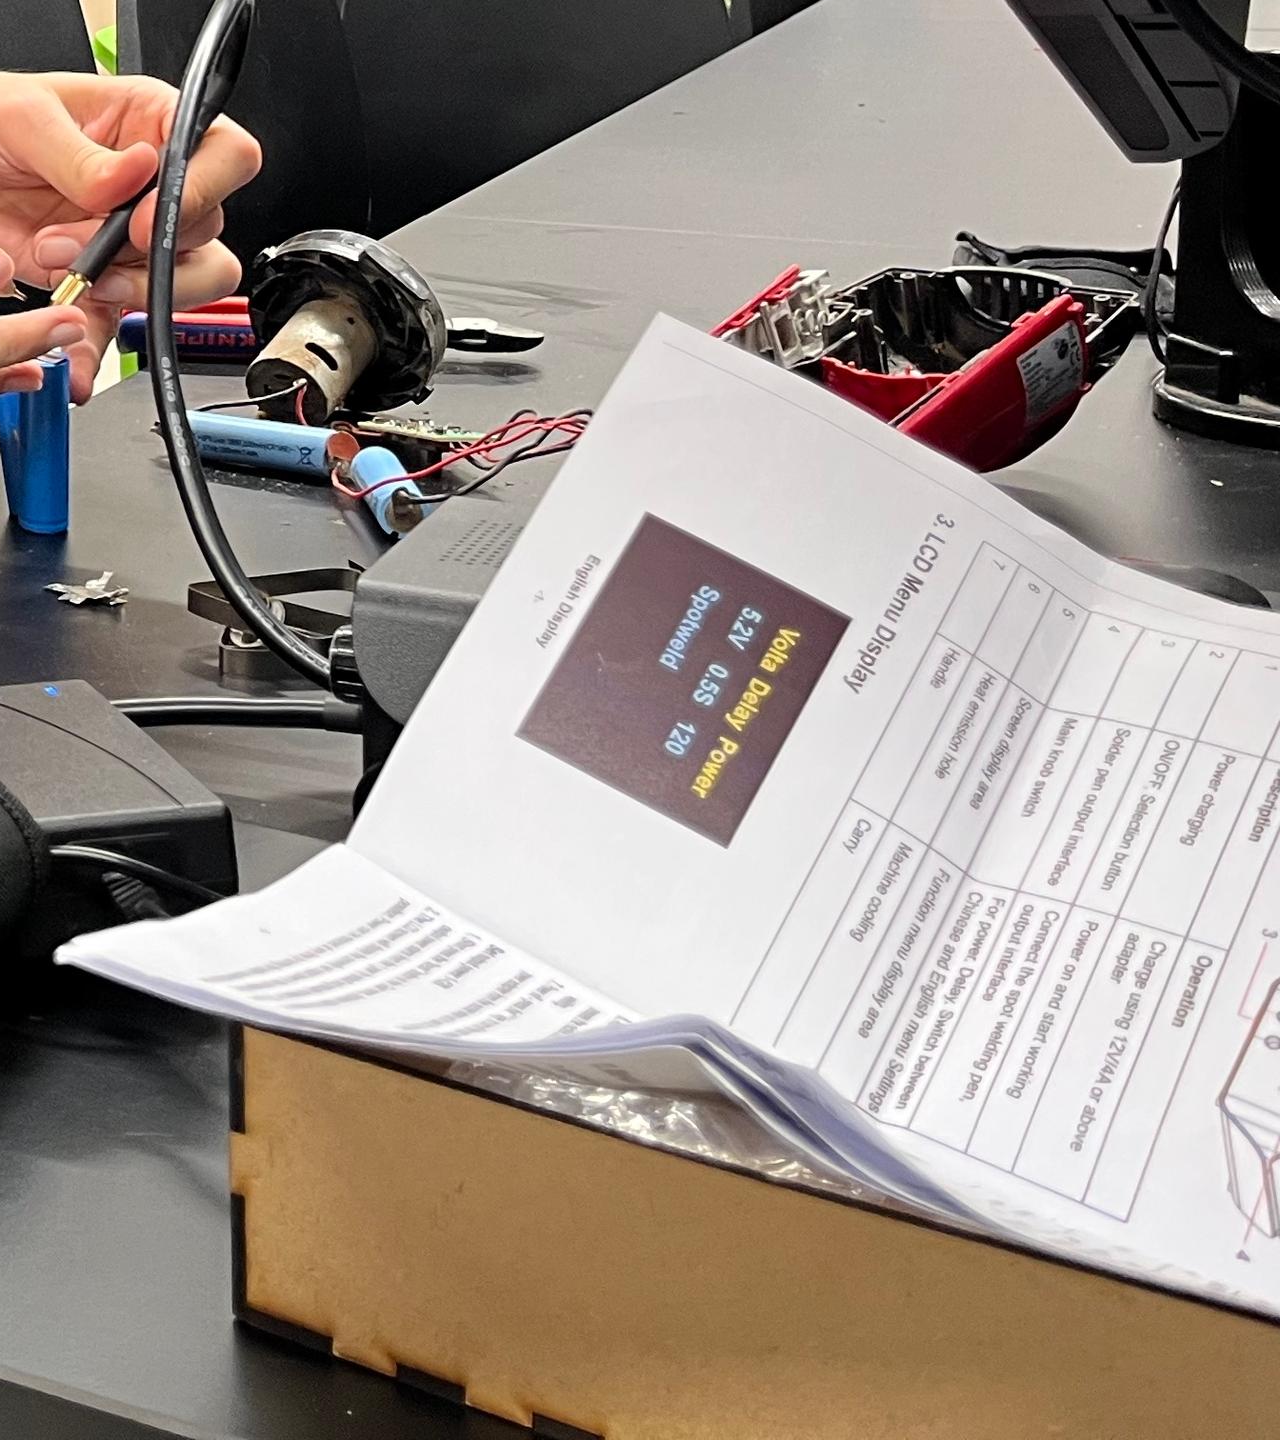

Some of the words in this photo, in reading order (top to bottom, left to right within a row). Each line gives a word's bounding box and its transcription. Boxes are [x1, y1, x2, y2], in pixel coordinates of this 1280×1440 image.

[173, 331, 257, 347] KNIPE
[929, 513, 957, 533] 3.
[912, 531, 947, 574] LCD
[565, 554, 602, 601] English
[883, 571, 925, 624] Menu
[535, 601, 574, 649] Display
[658, 585, 720, 671] Spotweld
[727, 606, 763, 651] 5.2V
[759, 628, 801, 673] Volta
[842, 623, 898, 695] Display
[929, 647, 961, 689] Handle
[692, 663, 729, 706] 0.5S
[724, 677, 772, 732] Delay
[972, 671, 998, 703] Heat
[664, 722, 696, 756] 120
[947, 700, 980, 753] emission
[1003, 696, 1033, 740] Screen
[1053, 717, 1079, 747] Main
[691, 736, 739, 799] Power
[934, 751, 959, 780] hole
[981, 738, 1011, 783] display
[1039, 748, 1065, 778] knob
[1103, 727, 1132, 767] Solder
[1090, 767, 1110, 792] pen
[1207, 753, 1237, 793] Power
[969, 780, 990, 811] area
[1020, 780, 1047, 818] switch
[1071, 793, 1098, 833] output
[1248, 767, 1280, 842] escription
[842, 818, 873, 855] Carry
[1118, 793, 1157, 850] Selection
[1178, 793, 1216, 847] charging
[875, 841, 914, 896] Machine
[1046, 834, 1084, 887] interface
[1100, 851, 1130, 892] button
[914, 867, 952, 923] Function
[948, 891, 984, 943] Chinese
[985, 896, 1007, 921] For
[848, 895, 883, 944] cooling
[896, 922, 922, 961] menu
[1007, 903, 1035, 946] output
[1023, 910, 1061, 965] Connect
[1069, 920, 1100, 963] Power
[935, 943, 956, 972] and
[981, 946, 1020, 1002] interface
[1013, 966, 1036, 988] the
[1060, 963, 1077, 982] on
[1109, 932, 1140, 985] adapter
[1133, 940, 1168, 990] Charge
[871, 960, 904, 1009] display
[912, 969, 947, 1020] English
[999, 989, 1022, 1019] spot
[1047, 983, 1068, 1011] and
[1170, 954, 1214, 1029] Operation
[857, 1006, 880, 1039] area
[1032, 1011, 1056, 1044] start
[1113, 992, 1142, 1031] using
[893, 1018, 920, 1060] menu
[922, 1008, 955, 1060] Switch
[972, 1020, 1009, 1072] welding
[1005, 1045, 1042, 1100] working
[1094, 1035, 1129, 1084] 12V/4A
[861, 1058, 905, 1115] Settings
[894, 1054, 938, 1119] between
[958, 1071, 983, 1103] pen,
[1088, 1086, 1104, 1104] or
[1069, 1104, 1097, 1153] above
